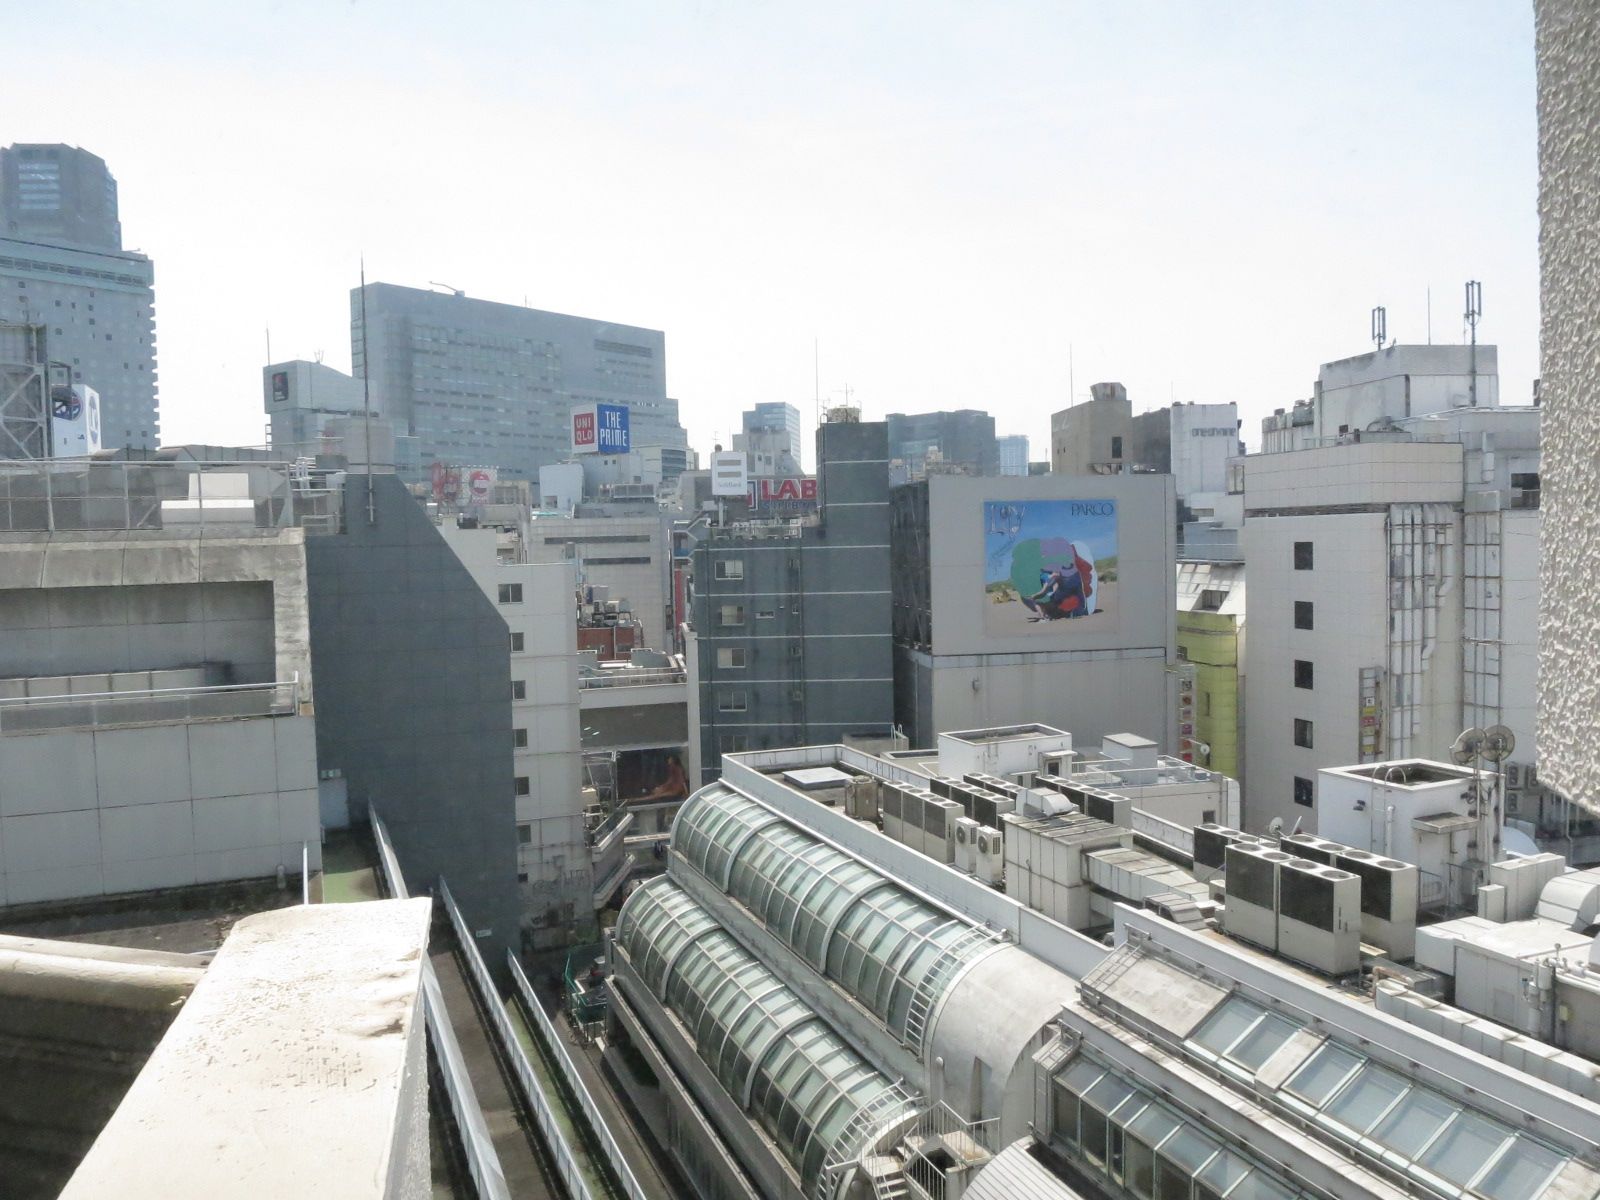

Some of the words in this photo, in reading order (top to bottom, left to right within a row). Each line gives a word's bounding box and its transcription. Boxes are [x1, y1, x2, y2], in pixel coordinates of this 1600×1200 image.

[576, 416, 592, 428] UNI
[605, 411, 621, 428] THE
[576, 430, 593, 443] QLO
[600, 428, 628, 446] PRIME
[1071, 502, 1114, 516] PARCO
